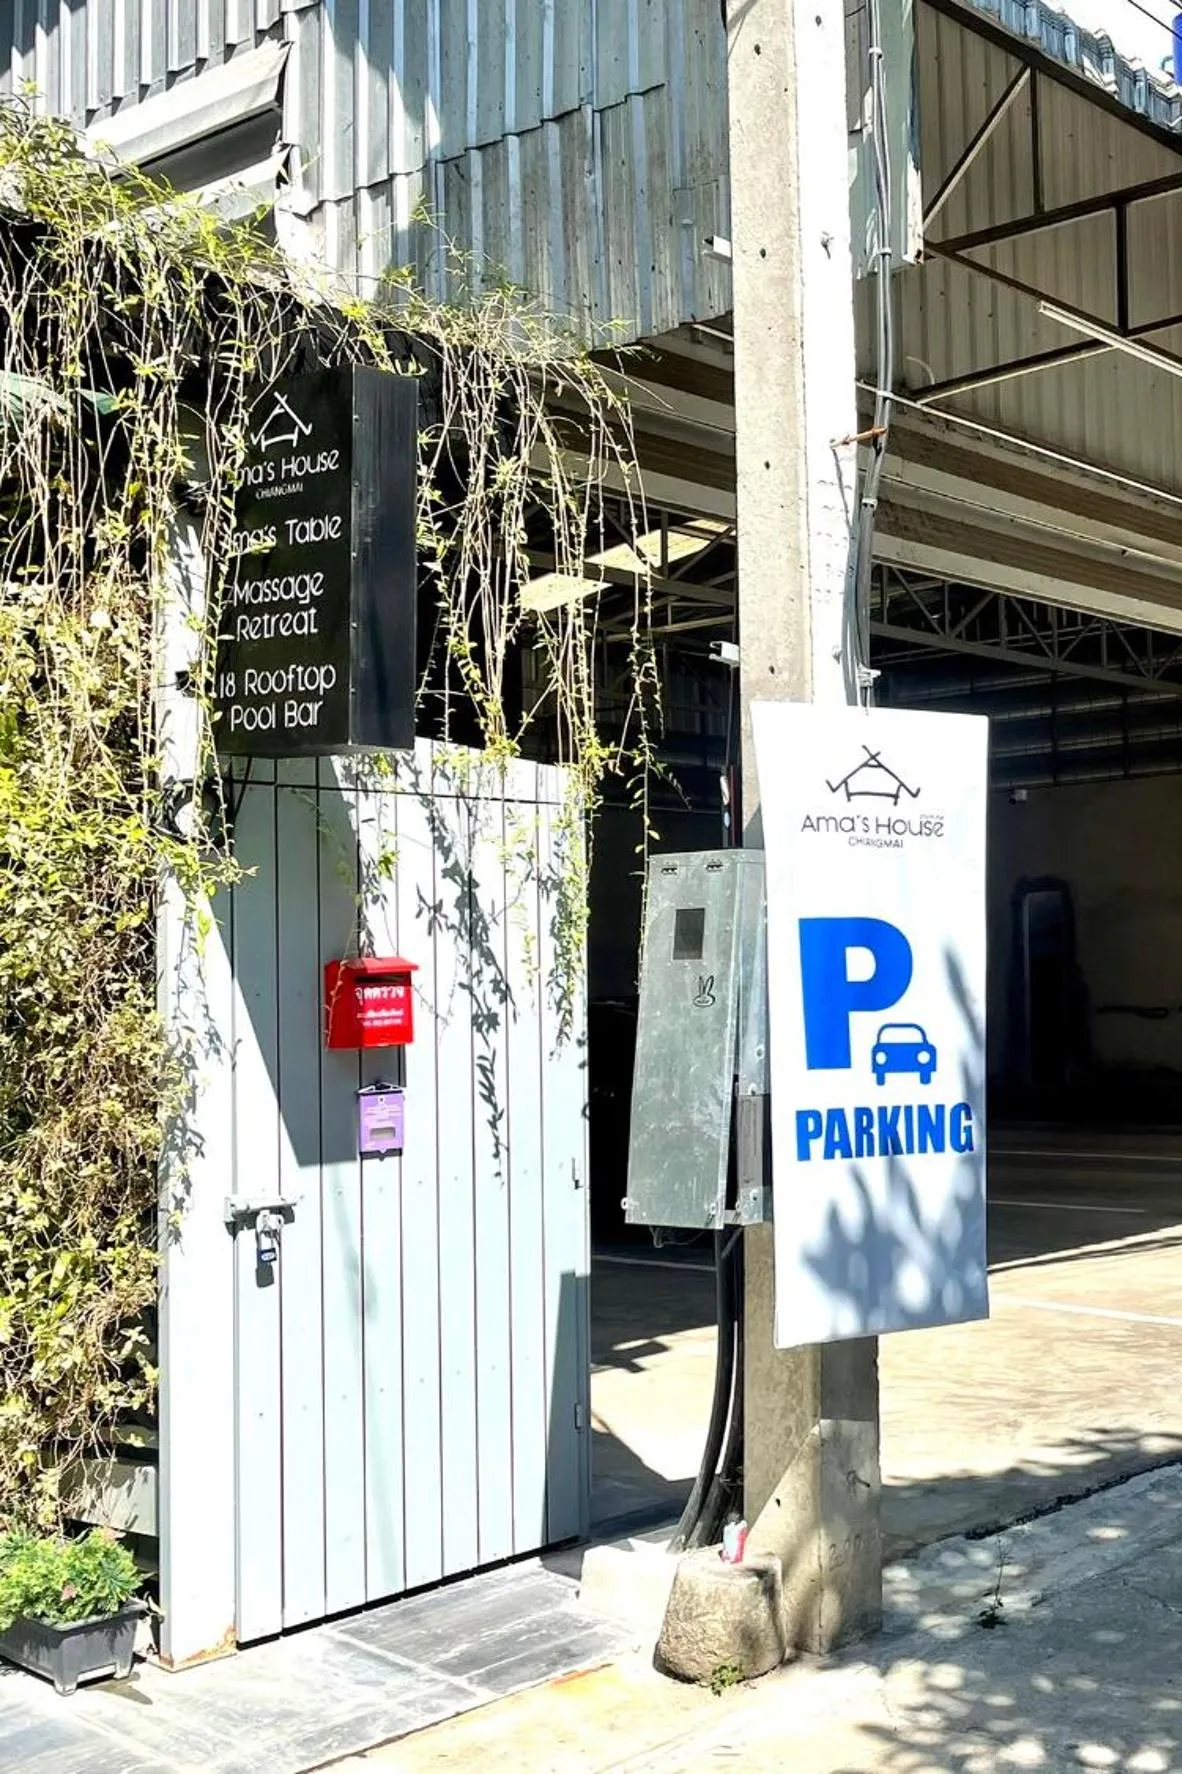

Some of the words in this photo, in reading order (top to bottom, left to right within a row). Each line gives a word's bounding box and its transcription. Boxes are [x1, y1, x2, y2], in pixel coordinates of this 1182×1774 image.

[234, 461, 275, 486] ma's
[281, 449, 340, 479] House
[230, 524, 276, 554] ma's
[284, 515, 341, 545] Table
[233, 571, 325, 607] Massage
[236, 606, 319, 642] Retreat
[219, 672, 236, 699] 18
[244, 664, 337, 697] Rooftop
[230, 702, 277, 732] Pool
[284, 700, 324, 729] Bar
[801, 813, 870, 833] Ama's
[875, 816, 945, 838] House
[798, 917, 913, 1071] P
[795, 1102, 975, 1162] PARKING
